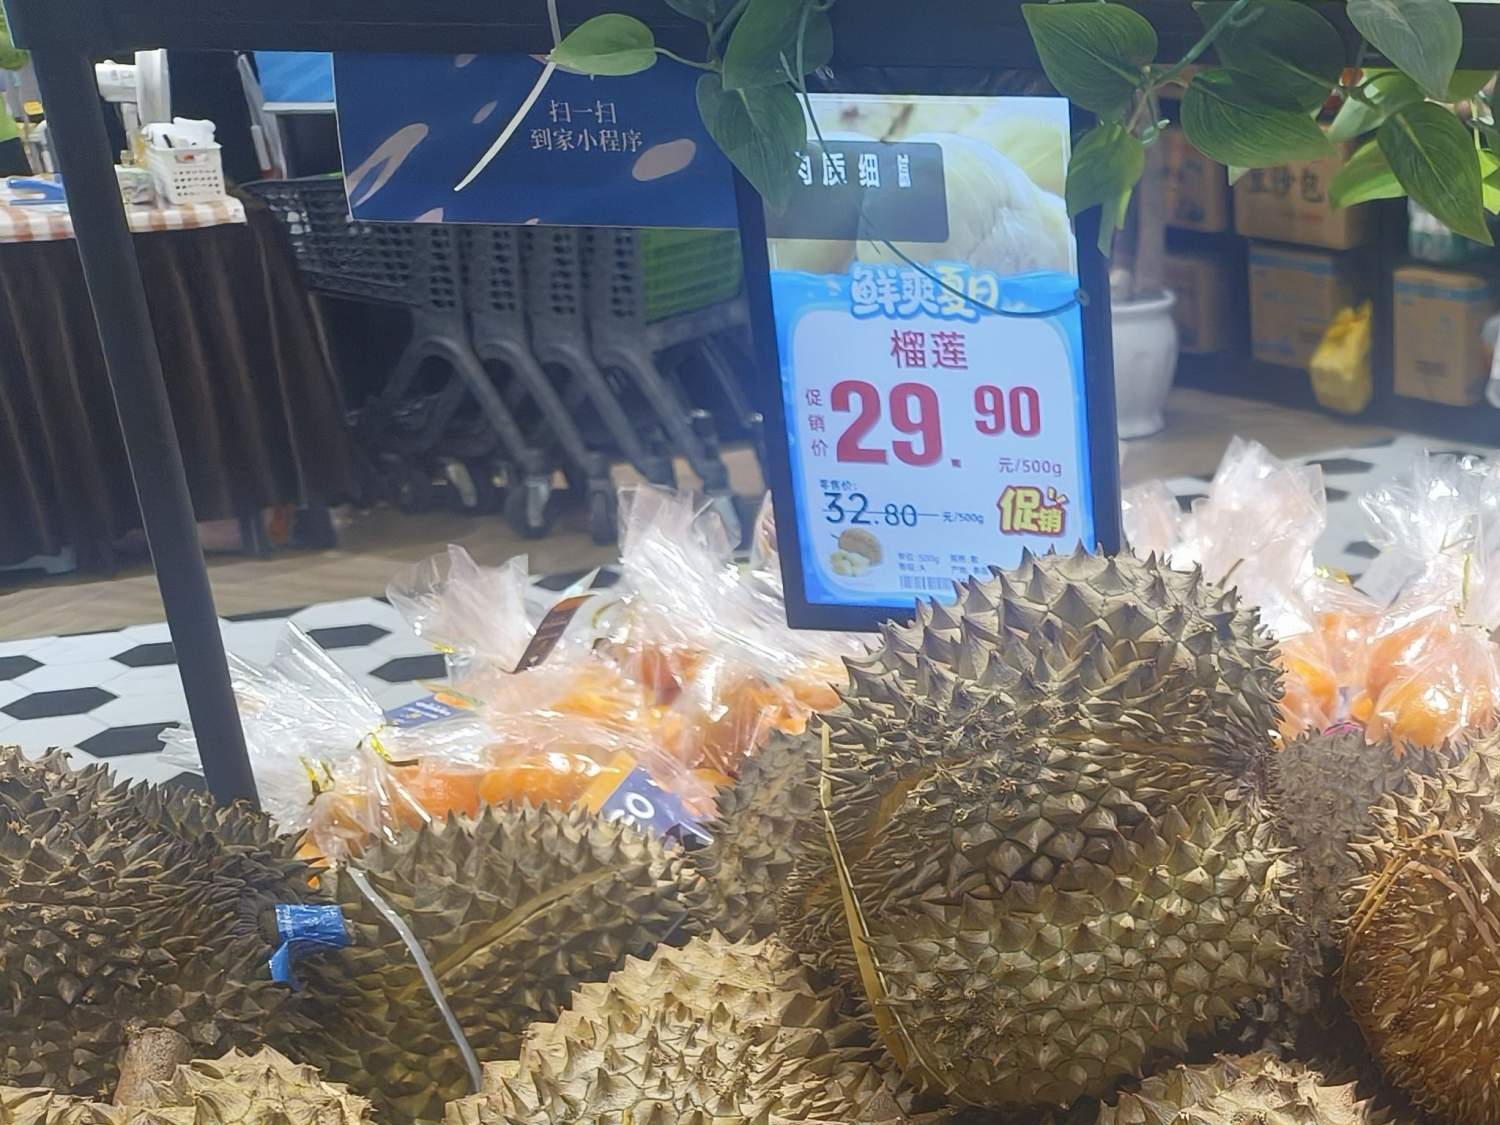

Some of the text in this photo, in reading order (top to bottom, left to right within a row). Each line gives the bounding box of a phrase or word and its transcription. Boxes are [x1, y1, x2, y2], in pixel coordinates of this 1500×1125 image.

[549, 100, 617, 125] 扫一扫
[530, 129, 643, 153] 到家小程序
[890, 328, 969, 371] 榴莲
[805, 387, 829, 458] 促销价
[998, 457, 1062, 477] 元/500g
[824, 492, 918, 527] 32.80
[942, 511, 984, 525] 元/500g
[999, 485, 1066, 535] 促销
